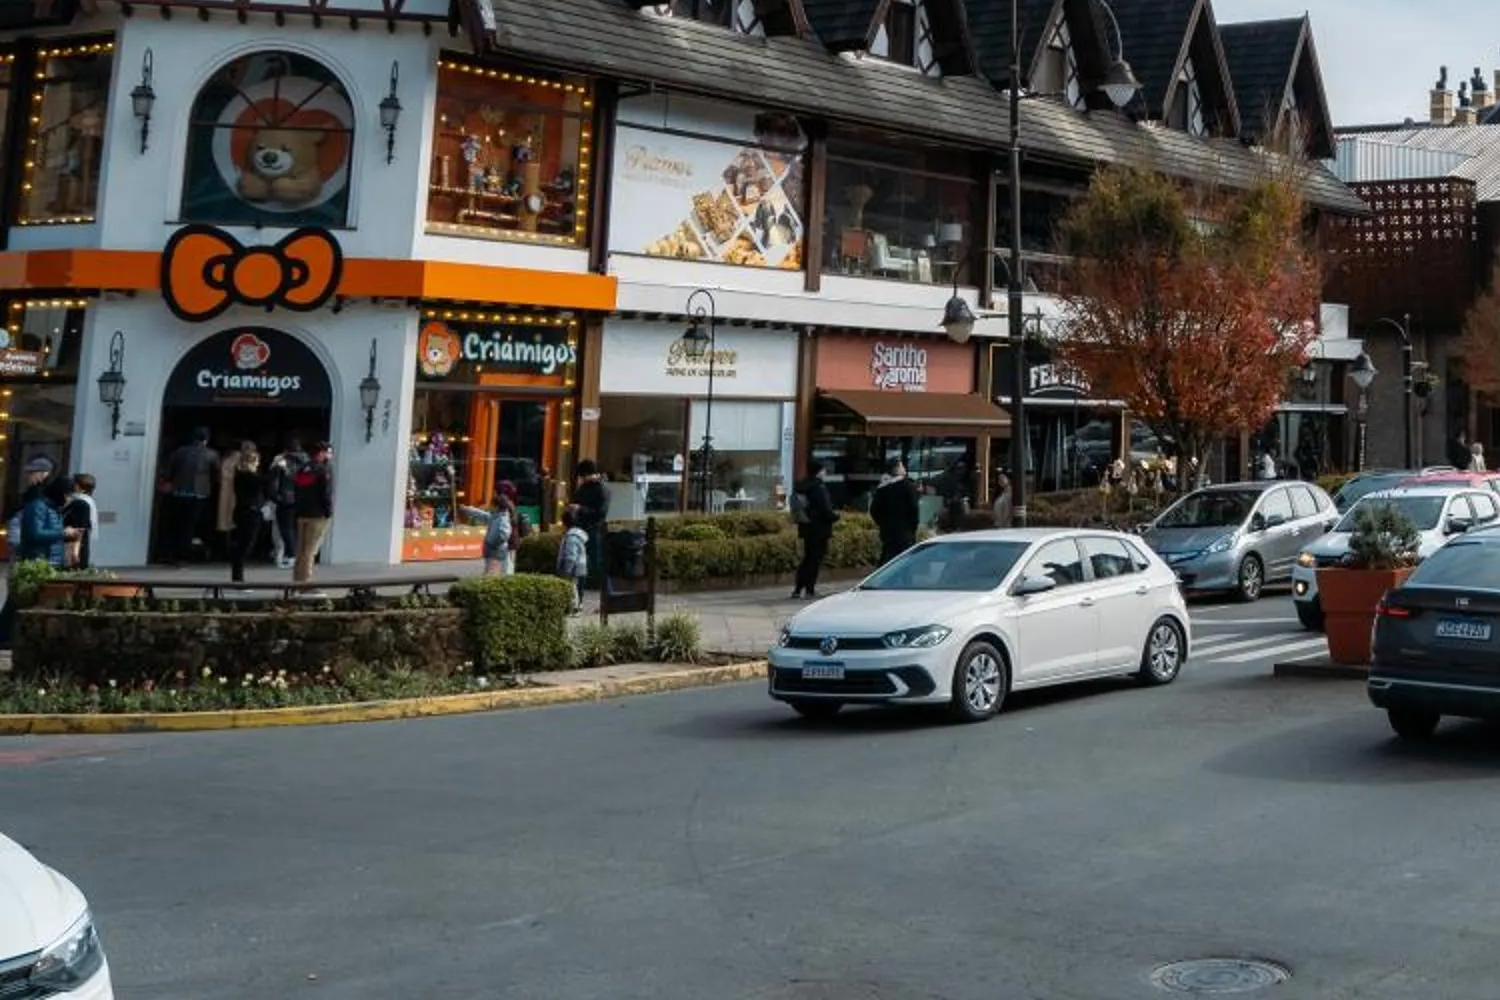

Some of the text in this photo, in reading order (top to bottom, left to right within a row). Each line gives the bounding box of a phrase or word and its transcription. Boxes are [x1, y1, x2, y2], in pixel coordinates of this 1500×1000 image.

[464, 332, 577, 374] Criamigos
[874, 341, 927, 366] Santho
[197, 370, 301, 397] Criamigos
